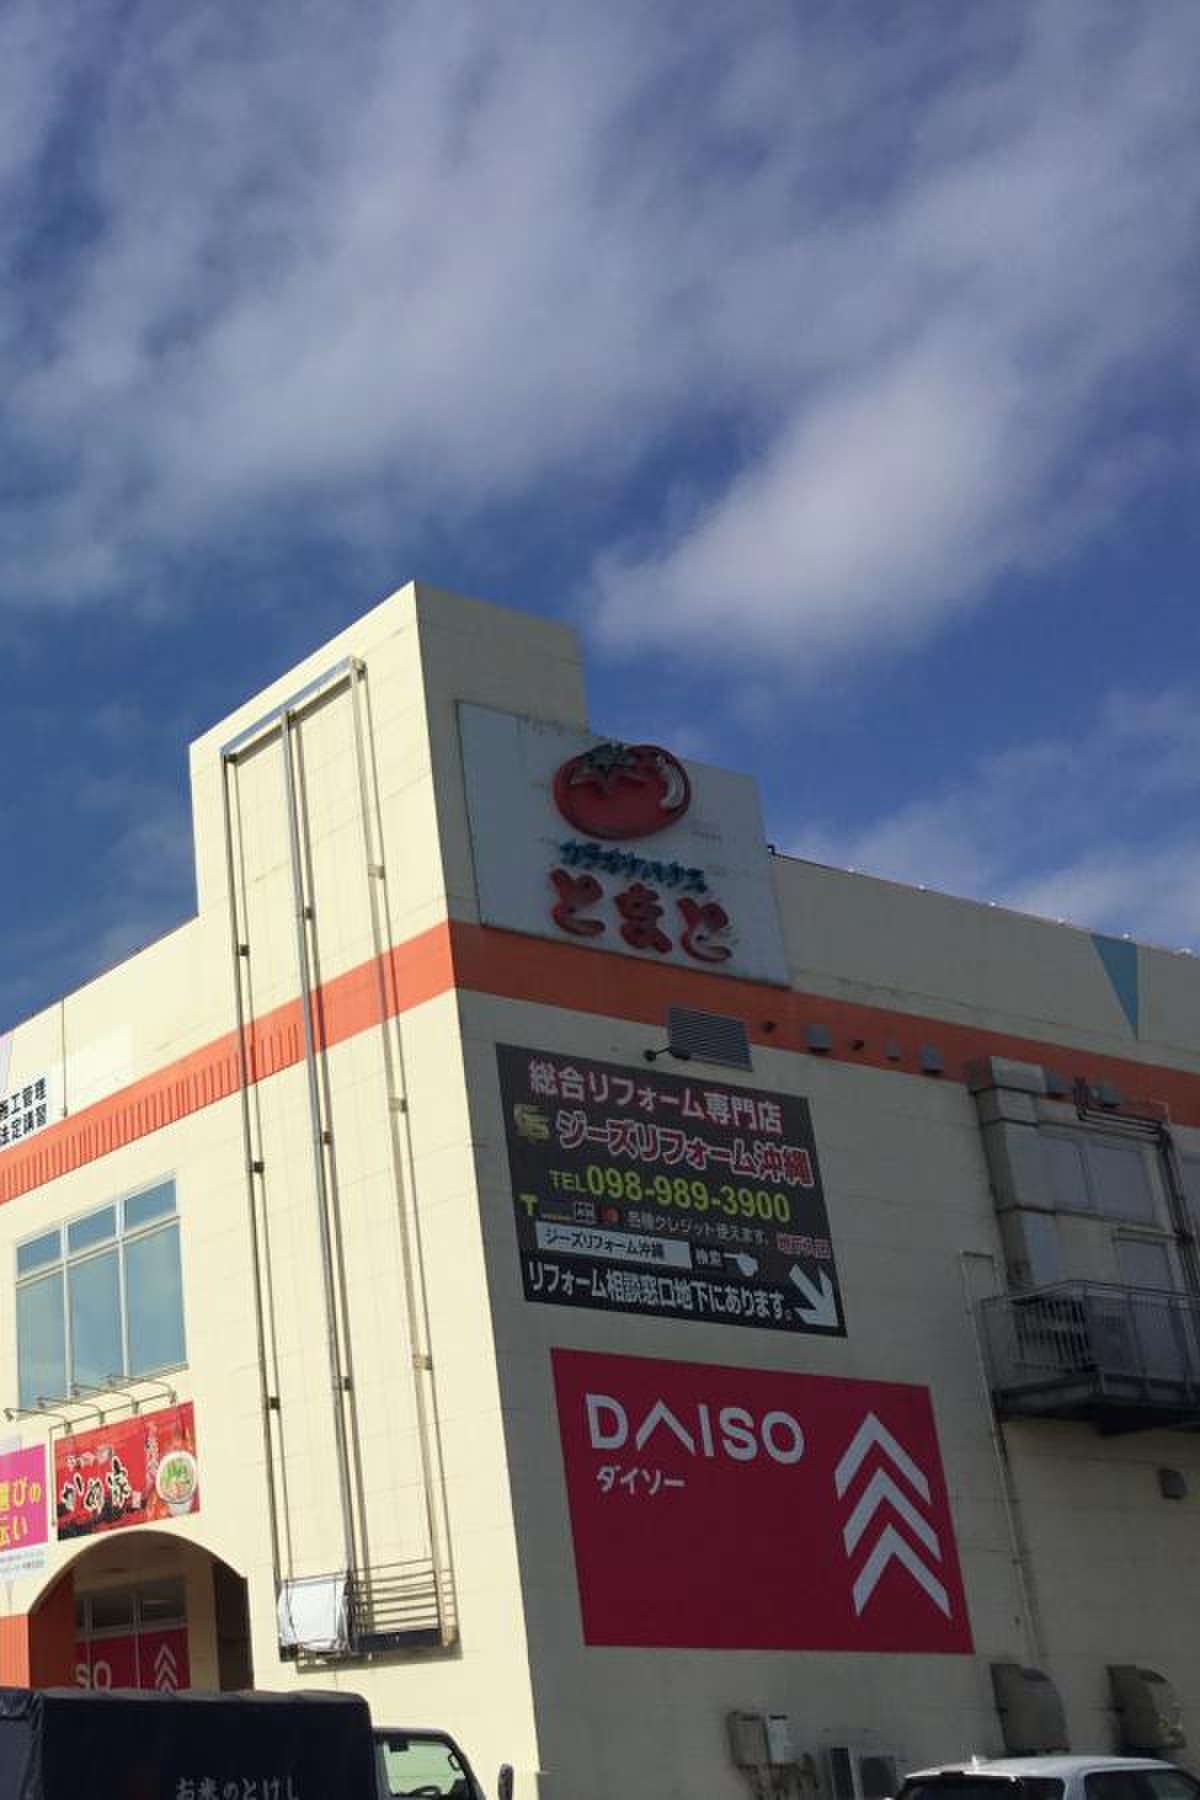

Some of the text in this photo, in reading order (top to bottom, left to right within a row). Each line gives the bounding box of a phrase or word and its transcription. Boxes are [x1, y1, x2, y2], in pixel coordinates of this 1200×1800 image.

[548, 867, 733, 963] とまと
[528, 1057, 783, 1135] 総合リフォーム専門店
[555, 1108, 815, 1188] ジーズリフォーム沖縄
[585, 1393, 805, 1464] DAISO
[597, 1465, 686, 1496] ダイソー
